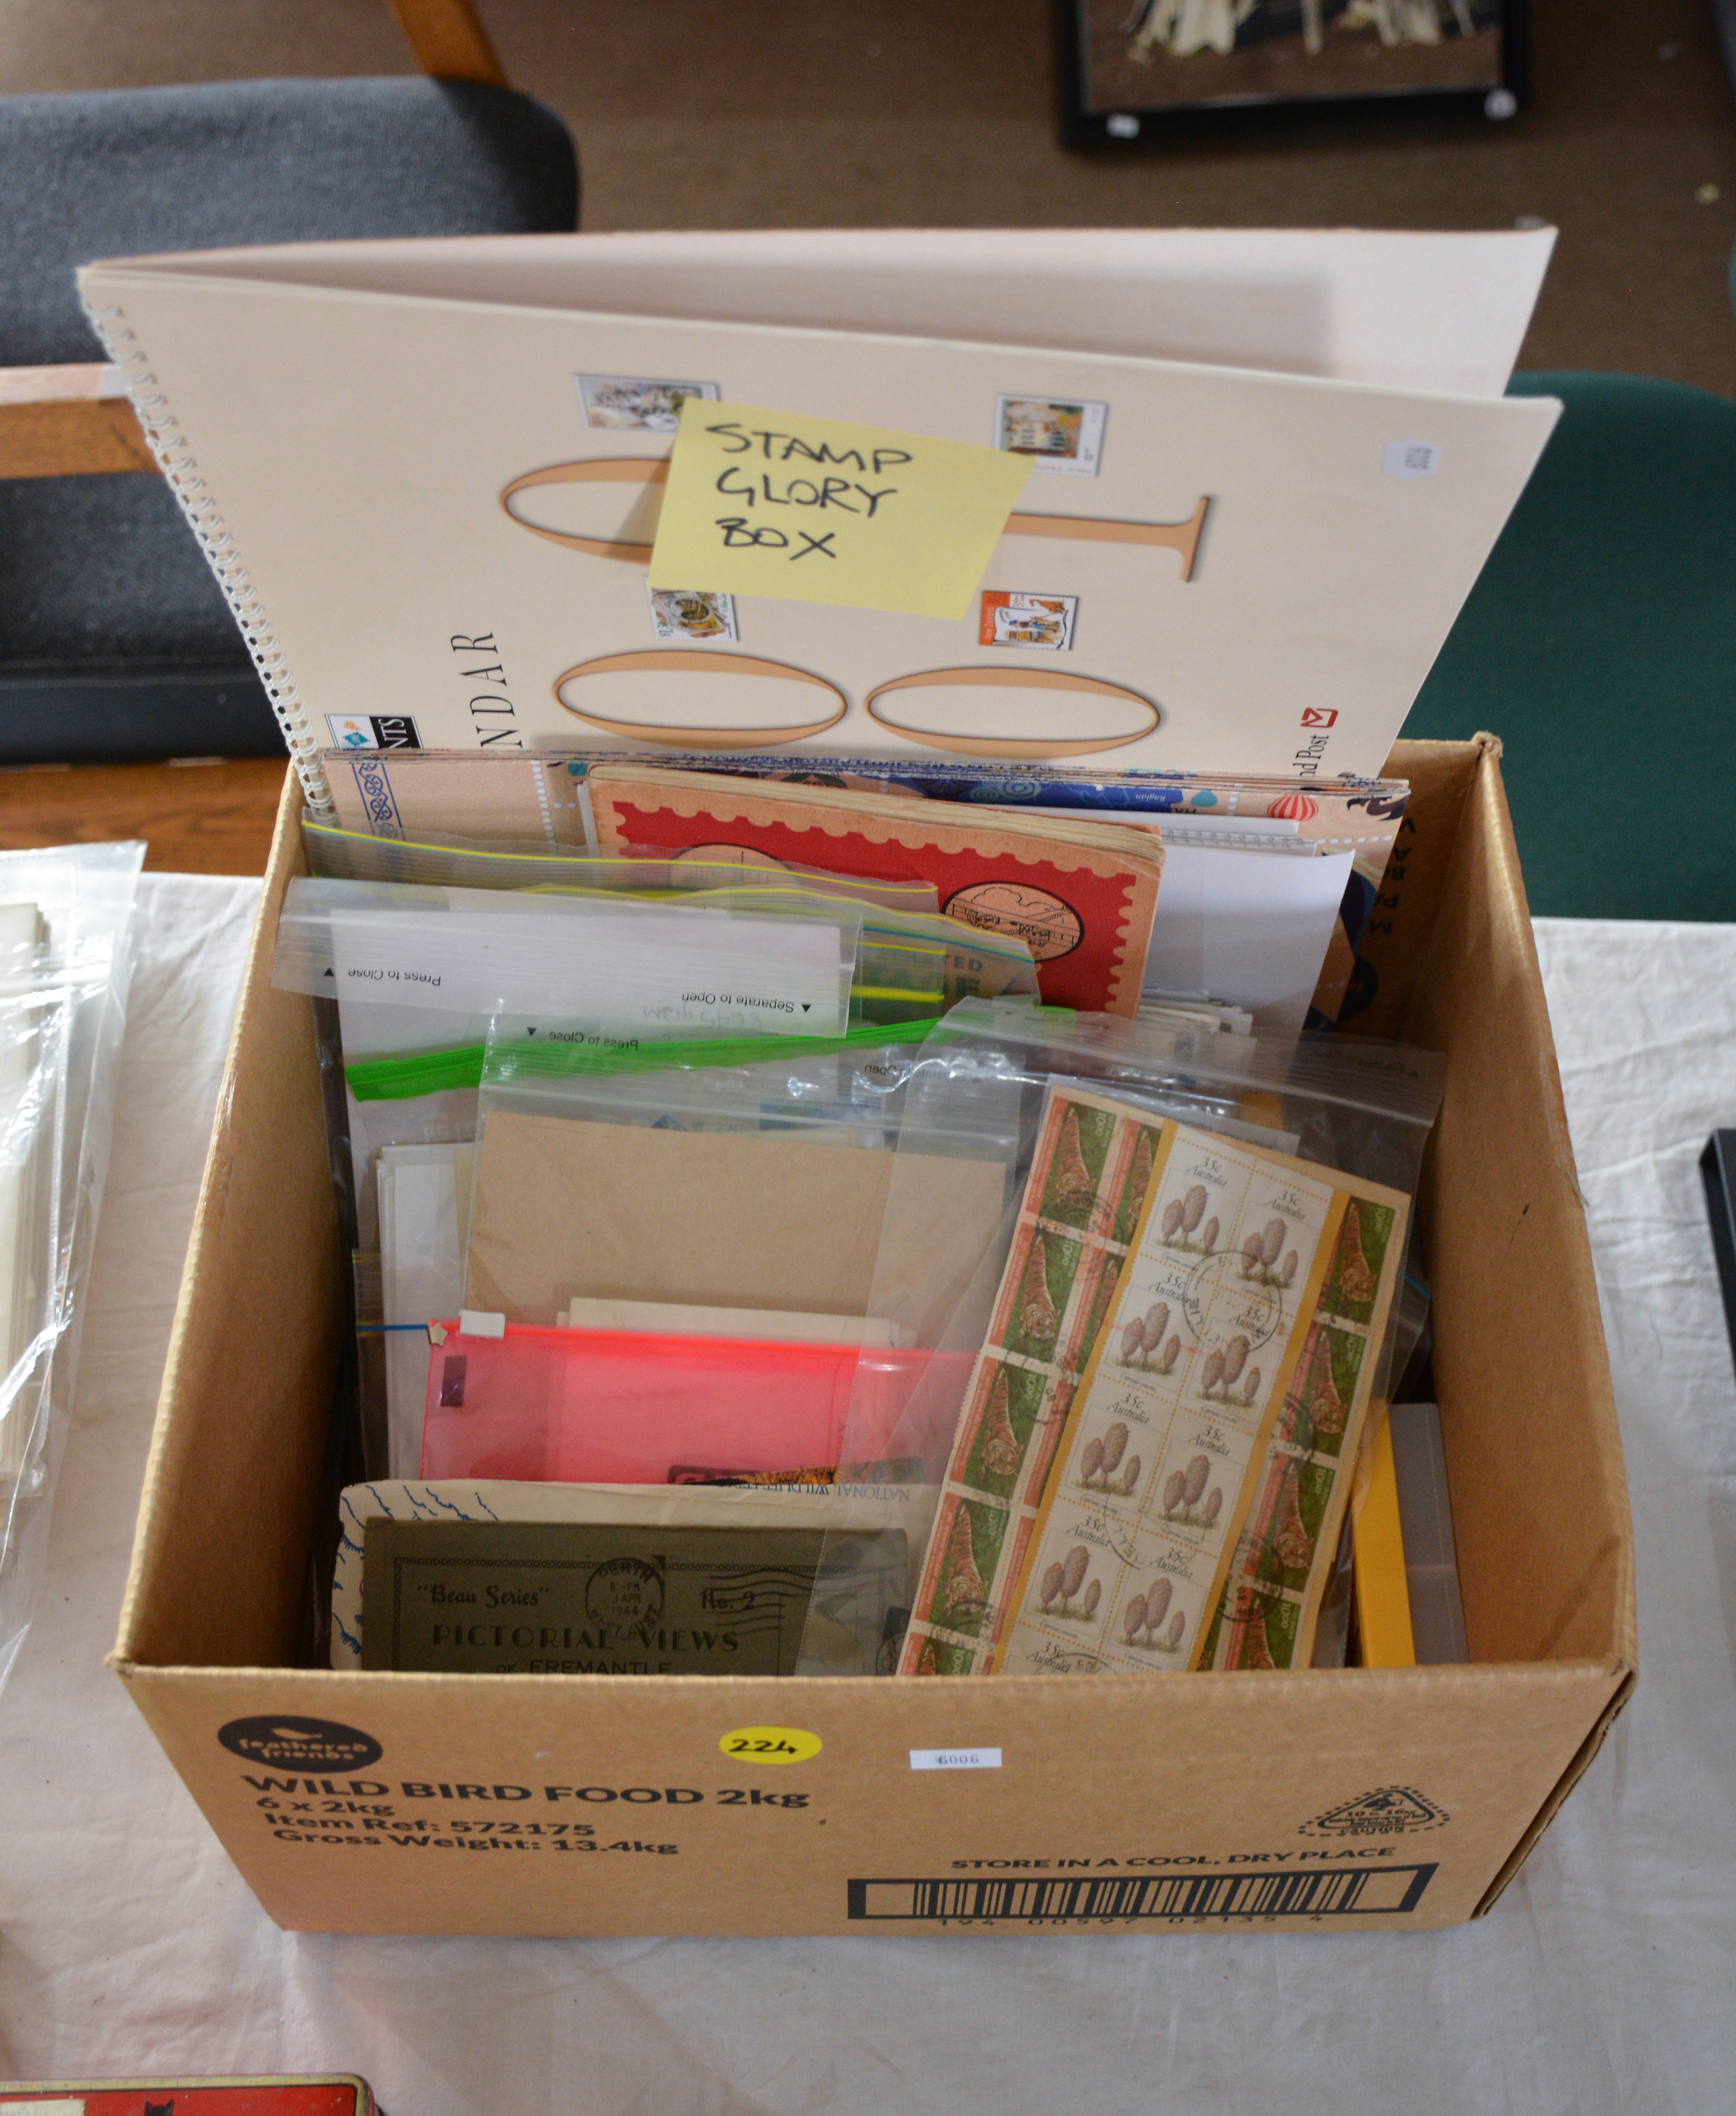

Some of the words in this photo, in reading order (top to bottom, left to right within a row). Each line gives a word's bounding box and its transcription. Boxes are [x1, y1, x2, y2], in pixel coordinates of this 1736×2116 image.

[705, 423, 913, 473] STAMP
[716, 467, 898, 517] GLORY
[715, 518, 837, 561] BOX
[450, 632, 524, 749] NDAR
[377, 718, 413, 749] NTS
[1295, 735, 1329, 760] Post
[348, 969, 384, 980] Close
[388, 969, 400, 980] to
[404, 970, 441, 987] Press
[681, 991, 716, 1005] Open
[719, 994, 732, 1005] to
[736, 996, 795, 1013] Separate
[1186, 1165, 1227, 1187] Australia
[1200, 1157, 1220, 1173] 35c
[1280, 1189, 1300, 1206] 35c
[1265, 1199, 1306, 1220] Australia
[1165, 1273, 1185, 1288] 35c
[1148, 1281, 1192, 1304] Australia
[1244, 1305, 1264, 1322] 35c
[1228, 1314, 1271, 1337] Australia
[1123, 1392, 1144, 1408] 35c
[1107, 1400, 1150, 1424] Australia
[1204, 1425, 1224, 1441] 35c
[1188, 1433, 1231, 1457] Australia
[1081, 1515, 1102, 1532] 35c
[1066, 1523, 1111, 1548] Australia
[1165, 1547, 1187, 1563] 35c
[1149, 1556, 1194, 1579] Australia
[433, 1624, 615, 1650] PICTORIAL
[638, 1629, 740, 1652] VIEWS
[727, 1739, 799, 1755] 224
[240, 1775, 390, 1797] WILD
[401, 1782, 533, 1802] BIRD
[544, 1785, 705, 1806] FOOD
[716, 1789, 811, 1809] 2kg
[256, 1797, 281, 1809] 6
[290, 1801, 314, 1812] x
[321, 1801, 396, 1817] 2kg
[264, 1812, 354, 1829] Item
[361, 1817, 441, 1833] Ref:
[450, 1821, 596, 1836] 572175
[273, 1829, 383, 1846] Gross
[387, 1834, 542, 1851] Weight:
[551, 1839, 679, 1855] 13.4kg
[950, 1858, 1052, 1870] STORE
[1057, 1858, 1092, 1868] IN
[1095, 1857, 1120, 1868] A
[1126, 1855, 1222, 1867] COOL,
[1227, 1852, 1297, 1864] DRY
[1298, 1847, 1398, 1861] PLACE
